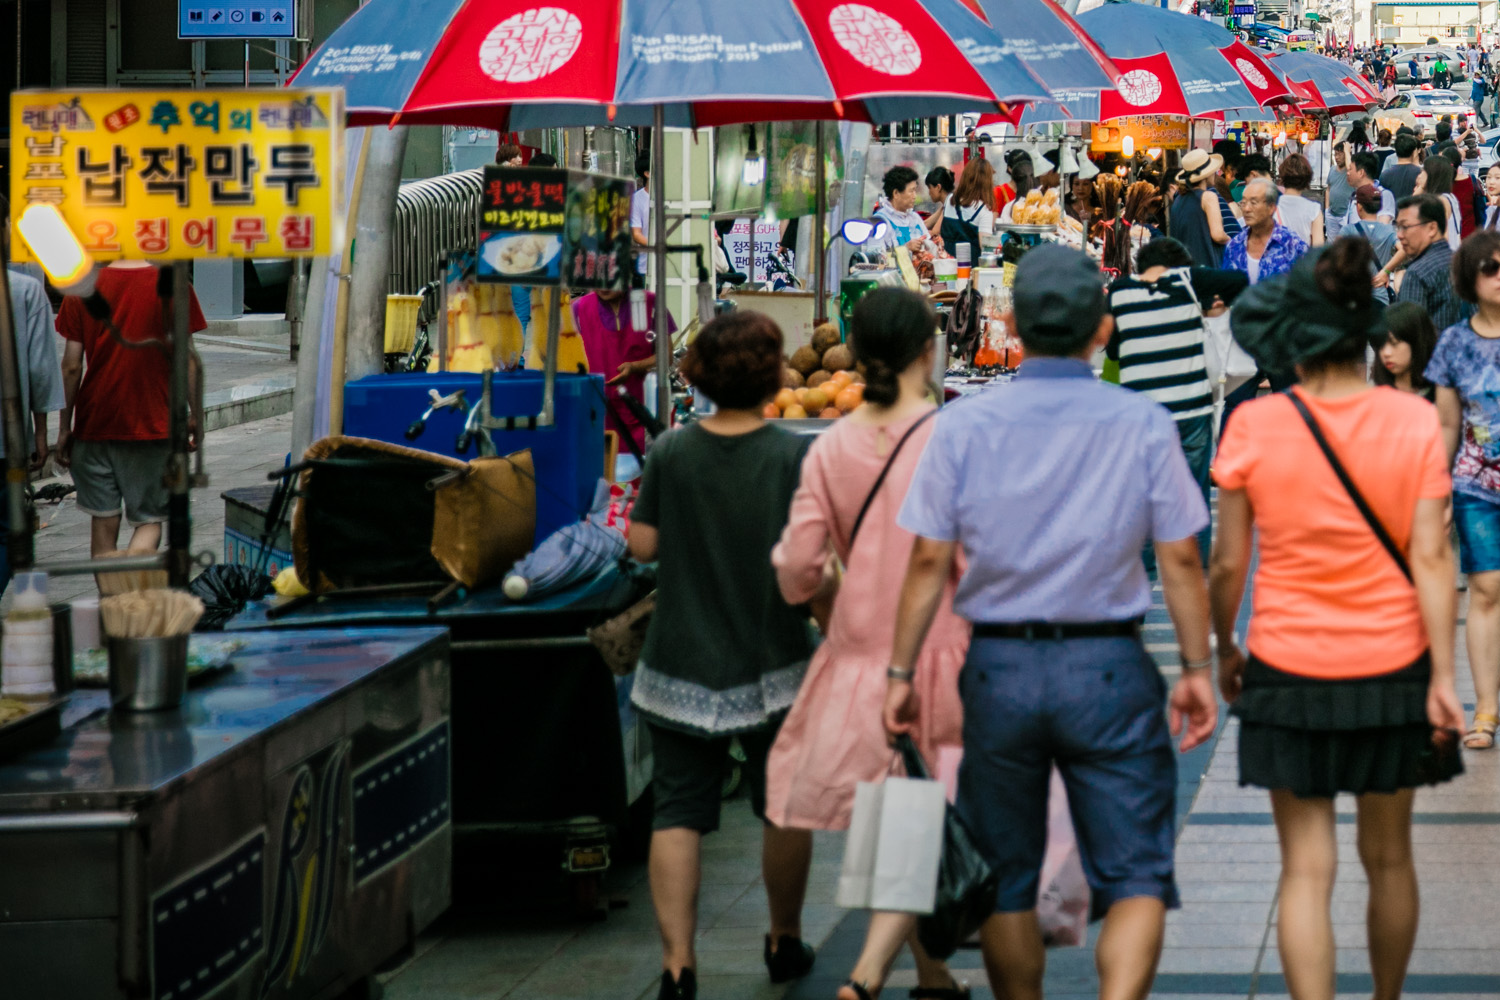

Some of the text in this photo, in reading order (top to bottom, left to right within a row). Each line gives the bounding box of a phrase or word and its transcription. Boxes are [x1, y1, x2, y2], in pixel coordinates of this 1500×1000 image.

[717, 42, 746, 54] Film
[749, 40, 803, 54] Festival
[149, 100, 221, 133] 추억
[76, 143, 319, 208] 납작만두
[84, 215, 314, 254] 오징어무침
[730, 223, 751, 235] 포동
